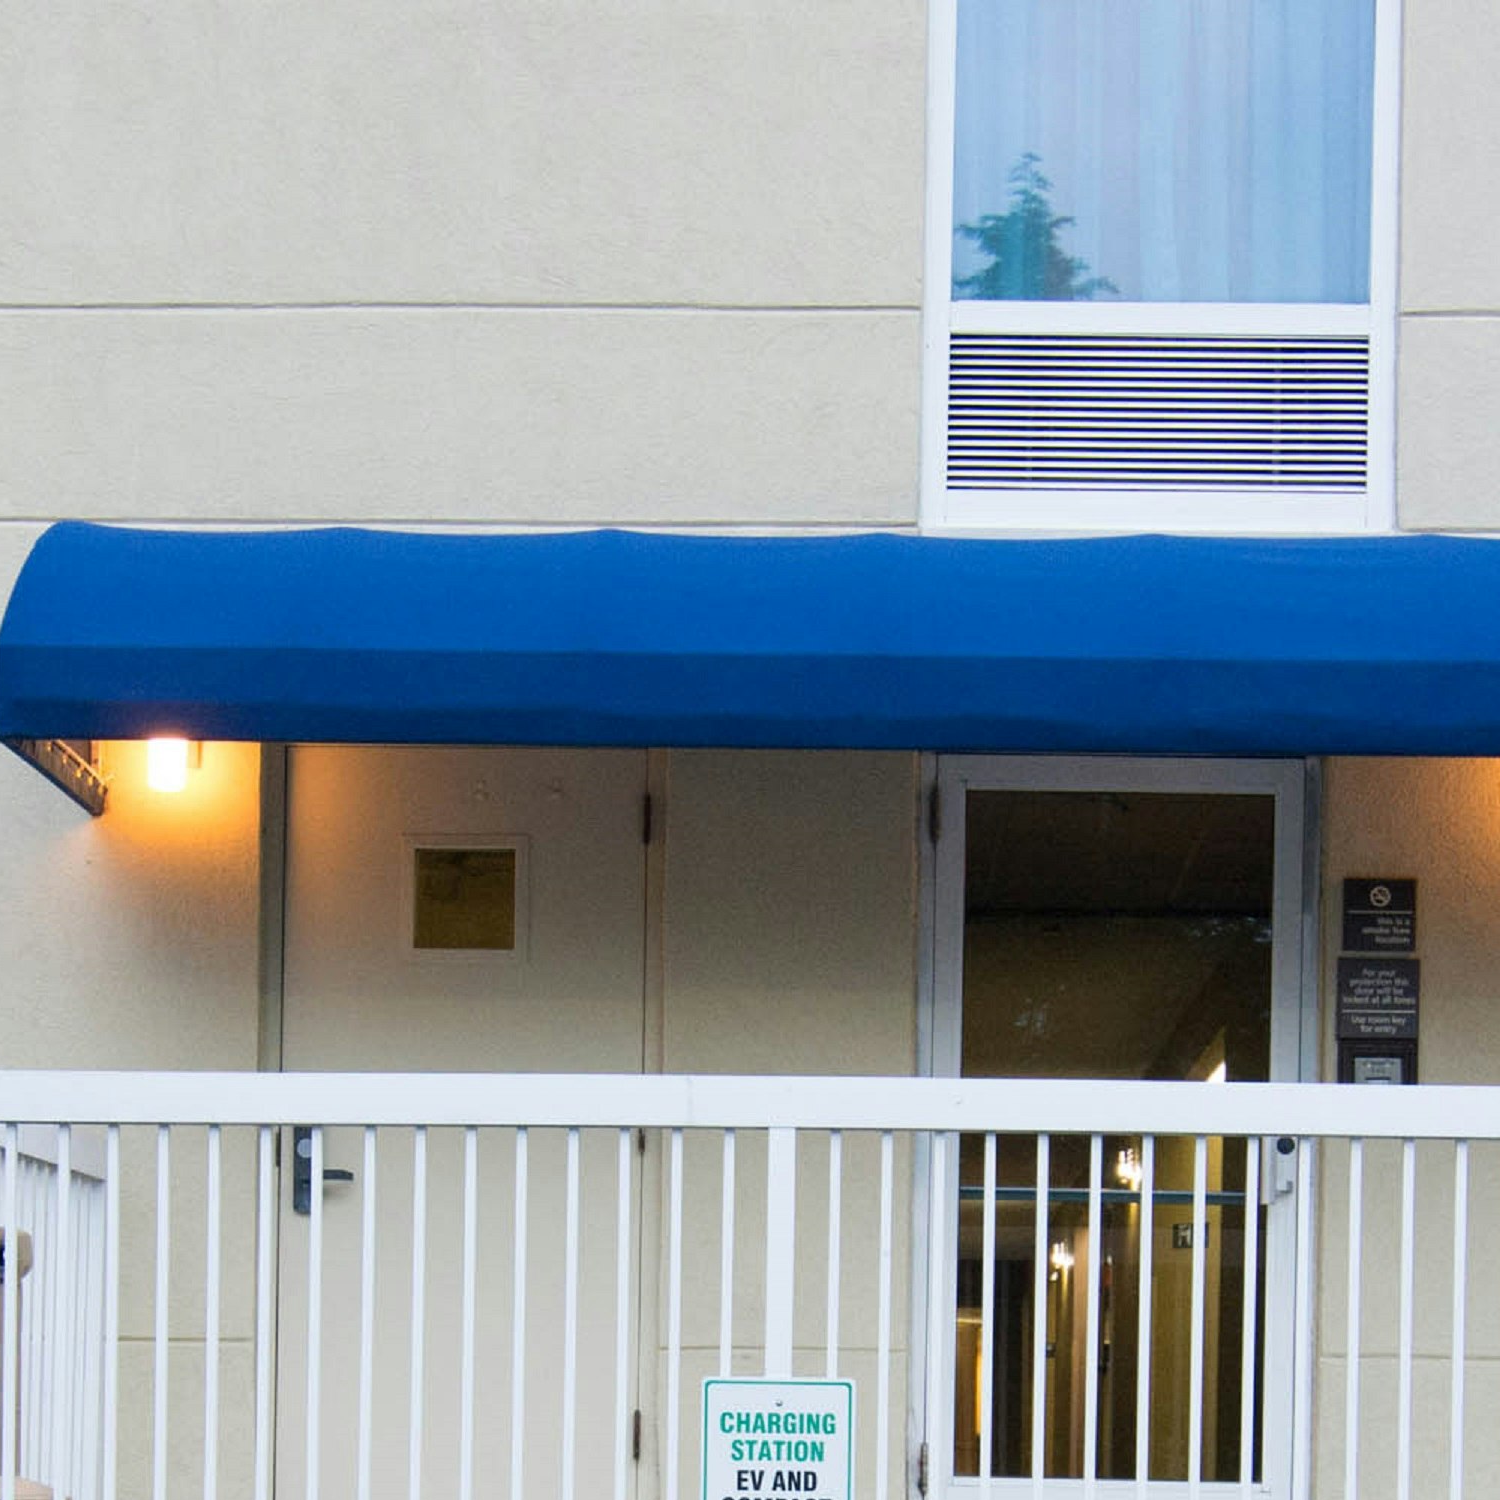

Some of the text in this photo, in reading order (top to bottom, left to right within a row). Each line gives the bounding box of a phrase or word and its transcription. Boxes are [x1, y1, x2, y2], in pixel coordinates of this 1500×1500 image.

[719, 1411, 837, 1435] CHARGING
[731, 1439, 825, 1463] STATION
[736, 1469, 818, 1492] EV AND
